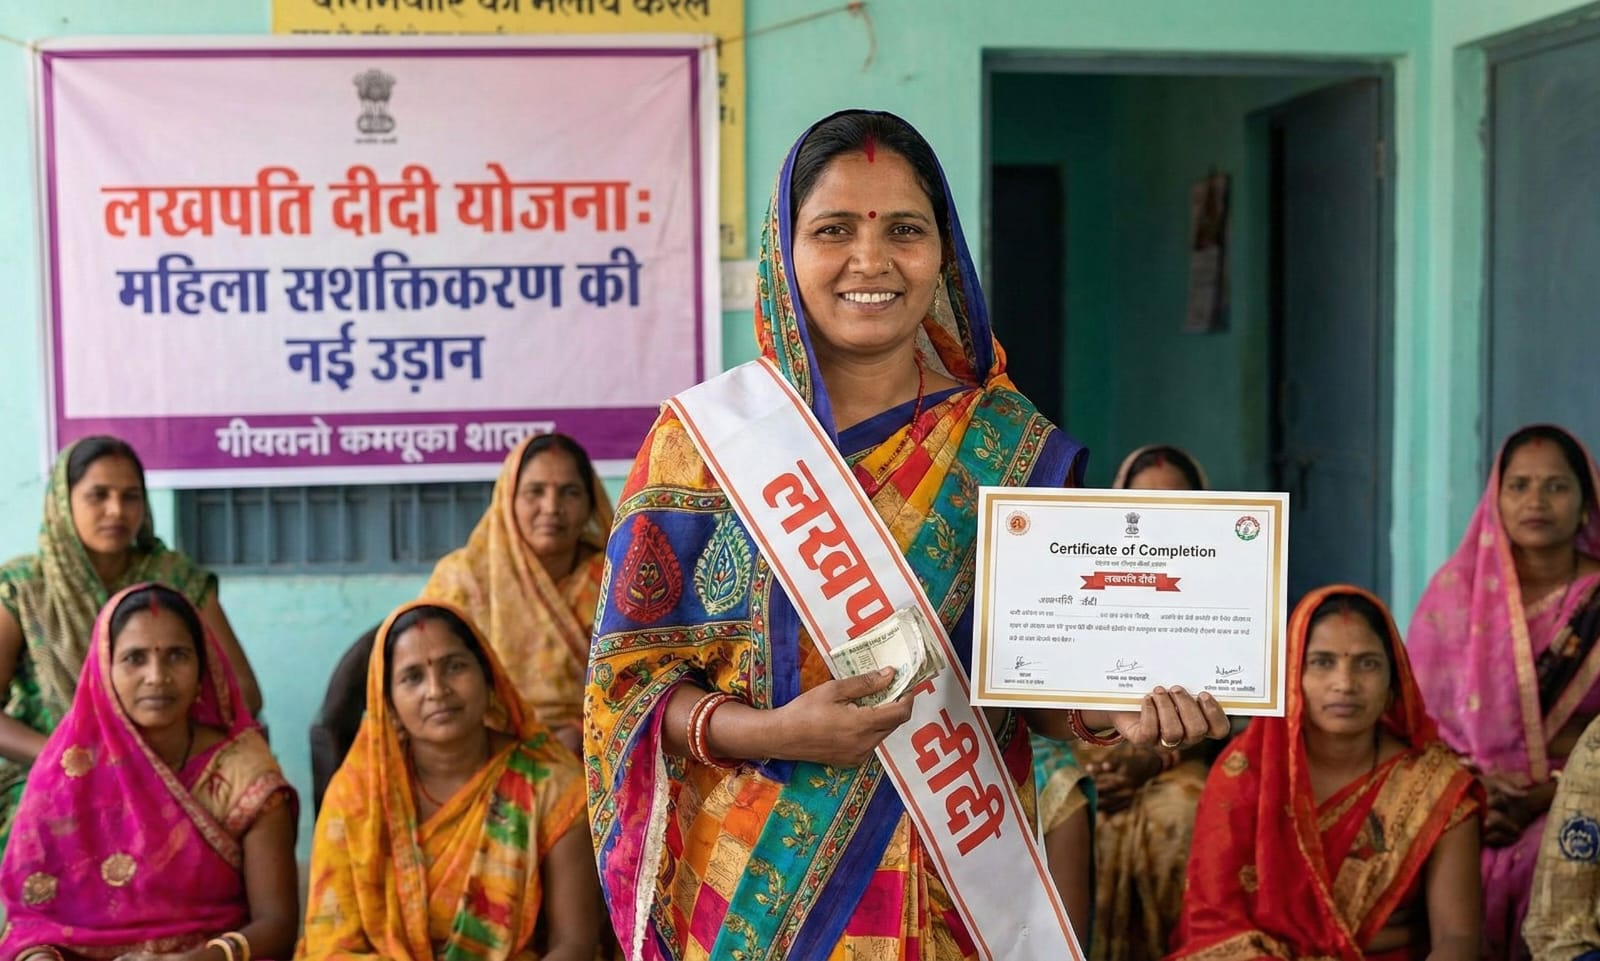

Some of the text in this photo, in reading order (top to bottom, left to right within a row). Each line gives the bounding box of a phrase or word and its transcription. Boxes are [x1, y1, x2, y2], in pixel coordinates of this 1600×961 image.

[101, 166, 315, 237] लखपति
[328, 165, 440, 236] दीदी
[116, 246, 642, 314] महिला सशक्तिकरण की
[285, 321, 485, 393] नई उड़ान
[1050, 542, 1217, 559] Certificate of Completion
[911, 708, 1006, 857] दीदी
